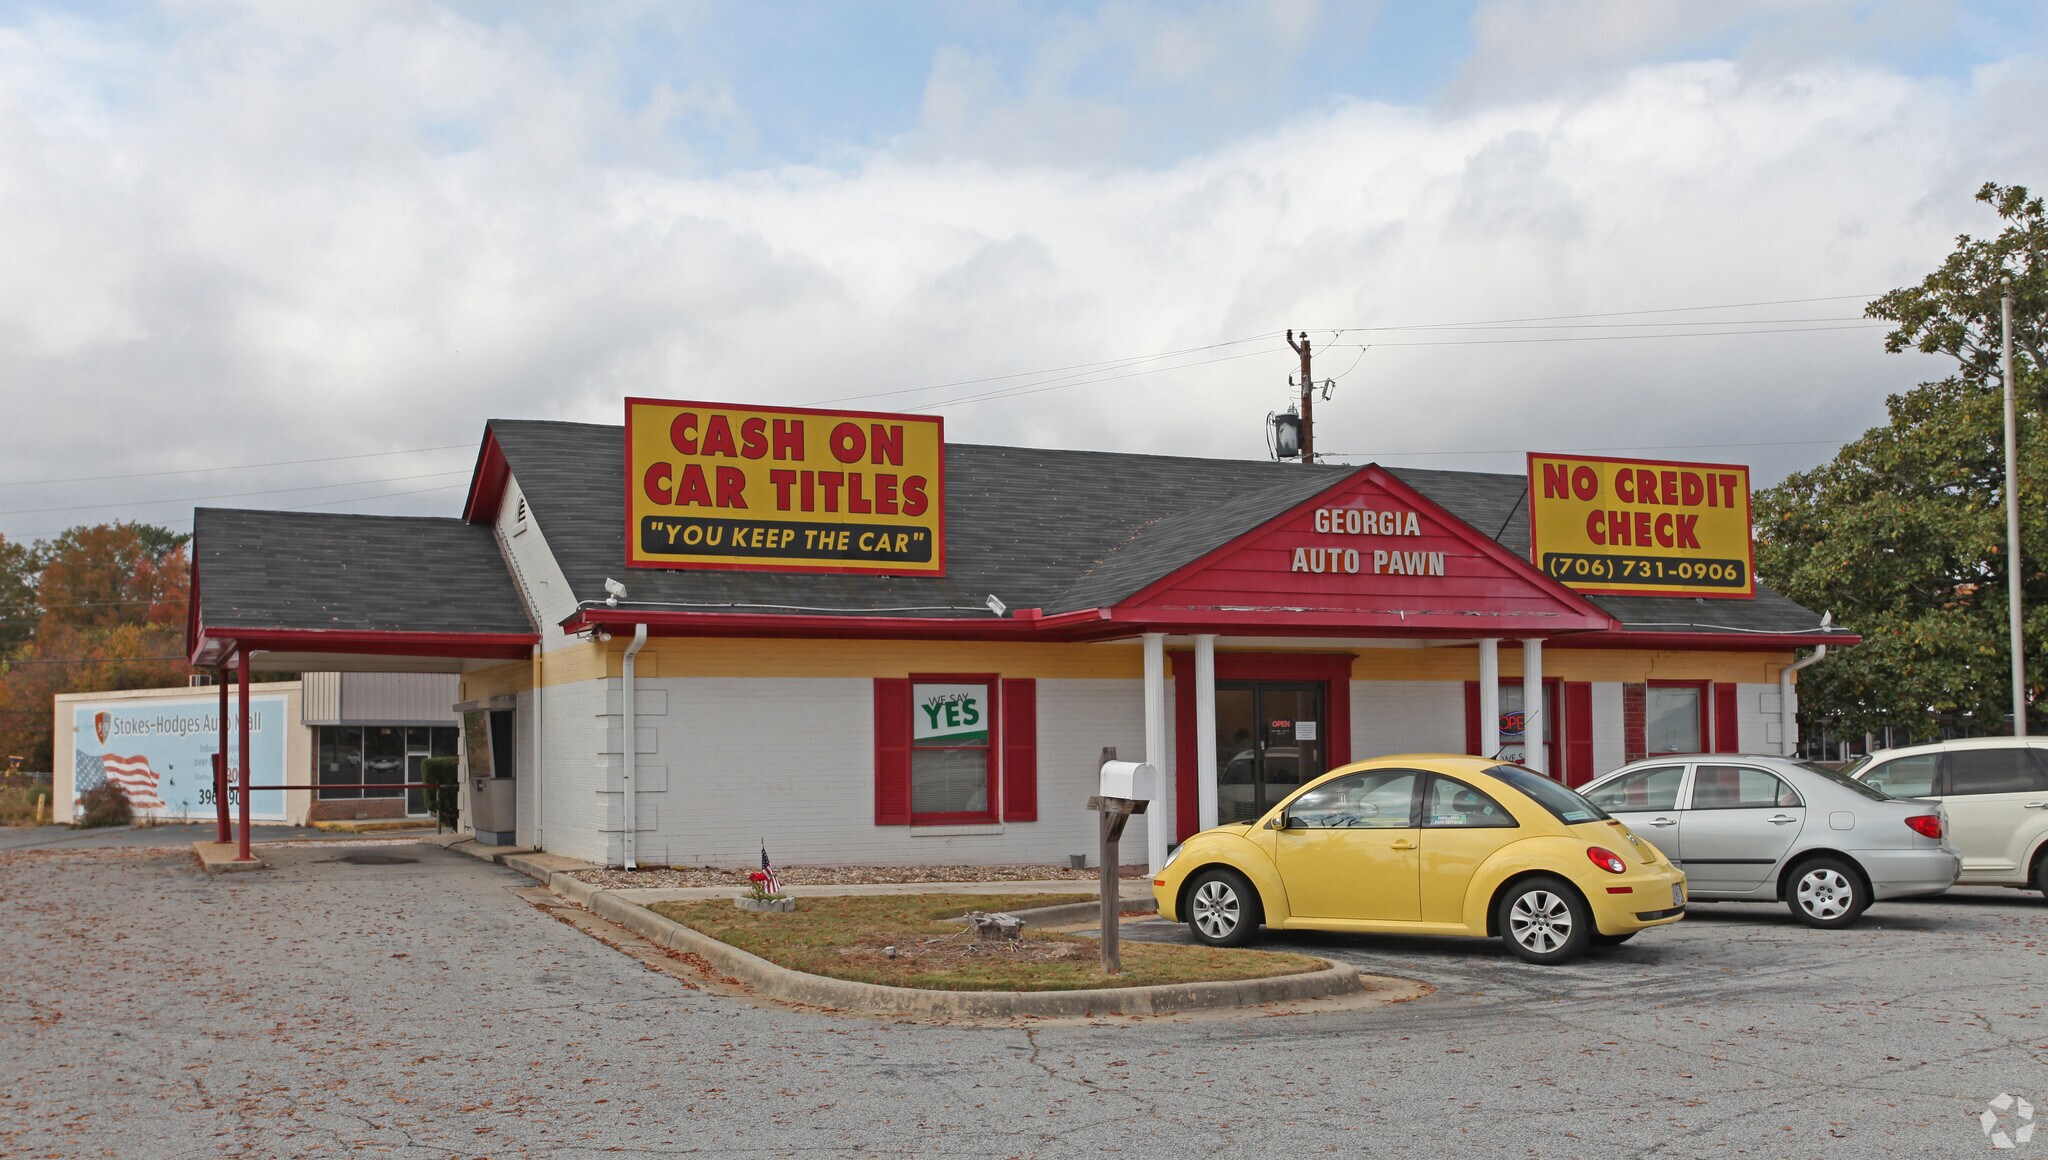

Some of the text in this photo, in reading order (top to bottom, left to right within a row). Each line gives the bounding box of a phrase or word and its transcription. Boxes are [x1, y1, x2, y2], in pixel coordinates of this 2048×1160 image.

[670, 412, 904, 466] CASH ON
[643, 461, 929, 517] CAR TITLES
[1543, 463, 1737, 508] NO CREDIT
[1315, 508, 1421, 536] GEORGIA
[1586, 509, 1701, 549] CHECK
[651, 521, 925, 553] "YOU KEEP THE CAR"
[1292, 547, 1444, 576] AUTO PAWN
[1550, 557, 1737, 581] (706) 731-0906
[921, 698, 980, 730] YES
[928, 693, 969, 706] WE SAY
[113, 715, 200, 737] Stokes-Hodges
[203, 714, 231, 732] Auo
[1271, 720, 1290, 728] OPEN
[1499, 715, 1524, 730] OPE
